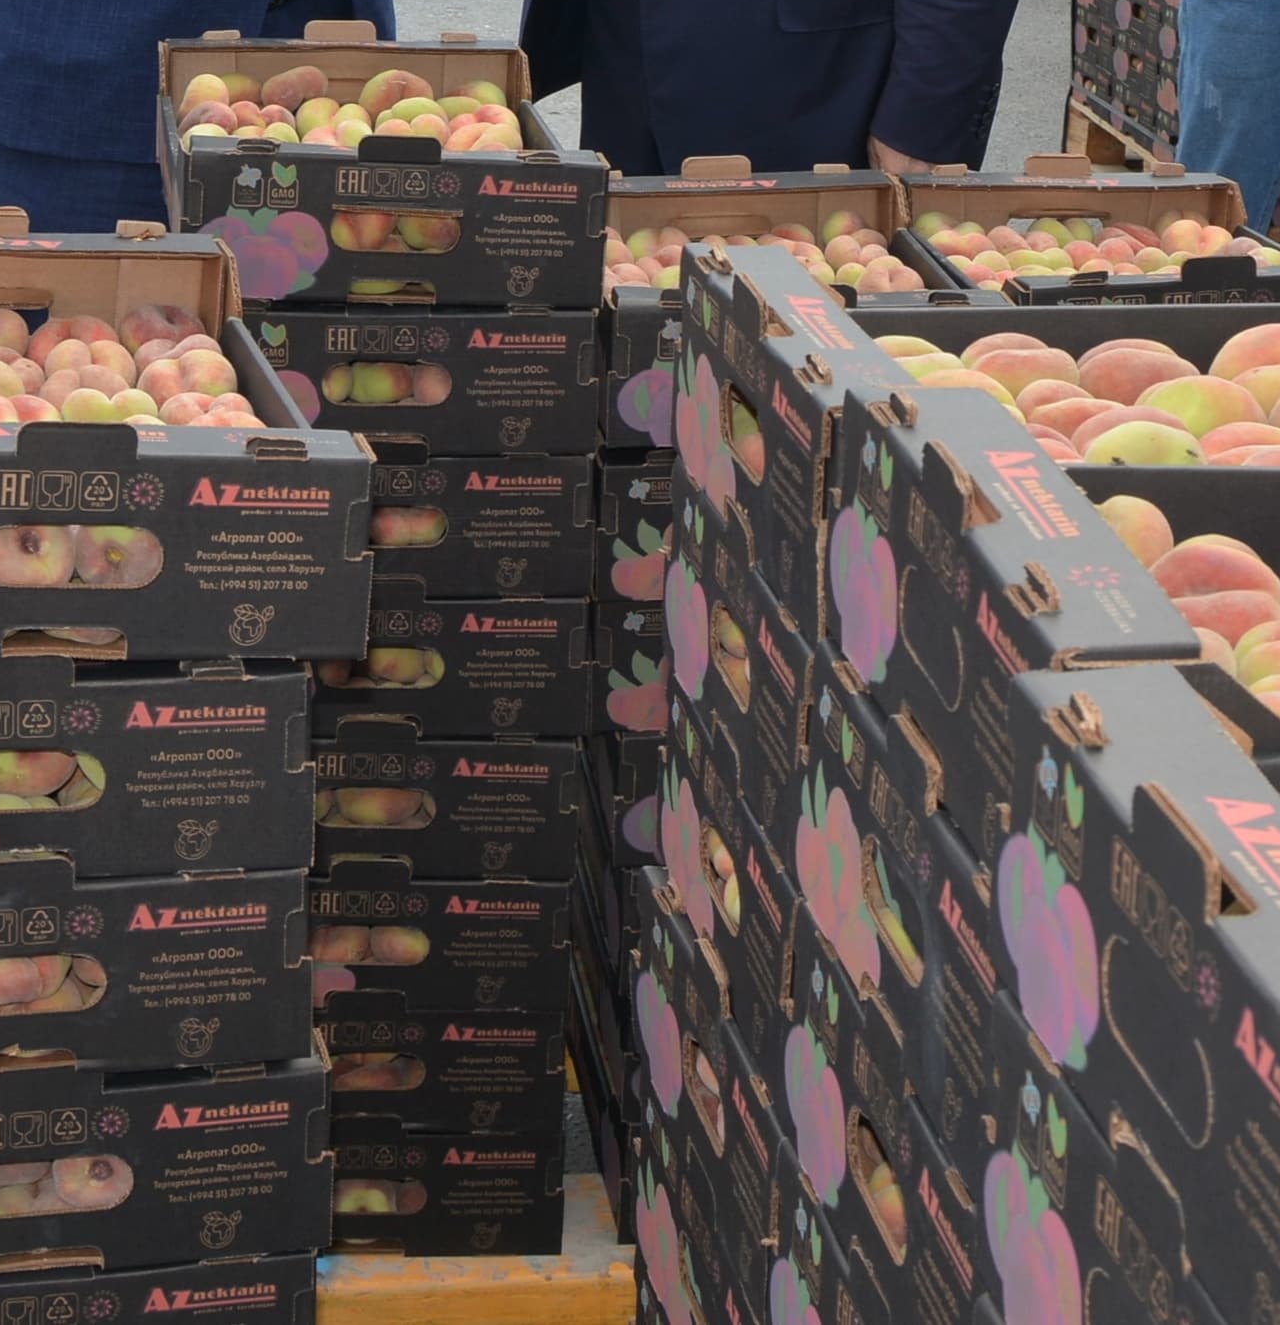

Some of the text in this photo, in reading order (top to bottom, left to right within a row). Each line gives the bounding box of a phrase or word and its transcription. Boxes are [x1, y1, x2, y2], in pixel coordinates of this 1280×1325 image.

[271, 189, 295, 199] GMO
[211, 531, 304, 545] «Агропат ООО»
[263, 580, 280, 590] 207
[282, 580, 293, 590] 78
[295, 580, 308, 590] 00
